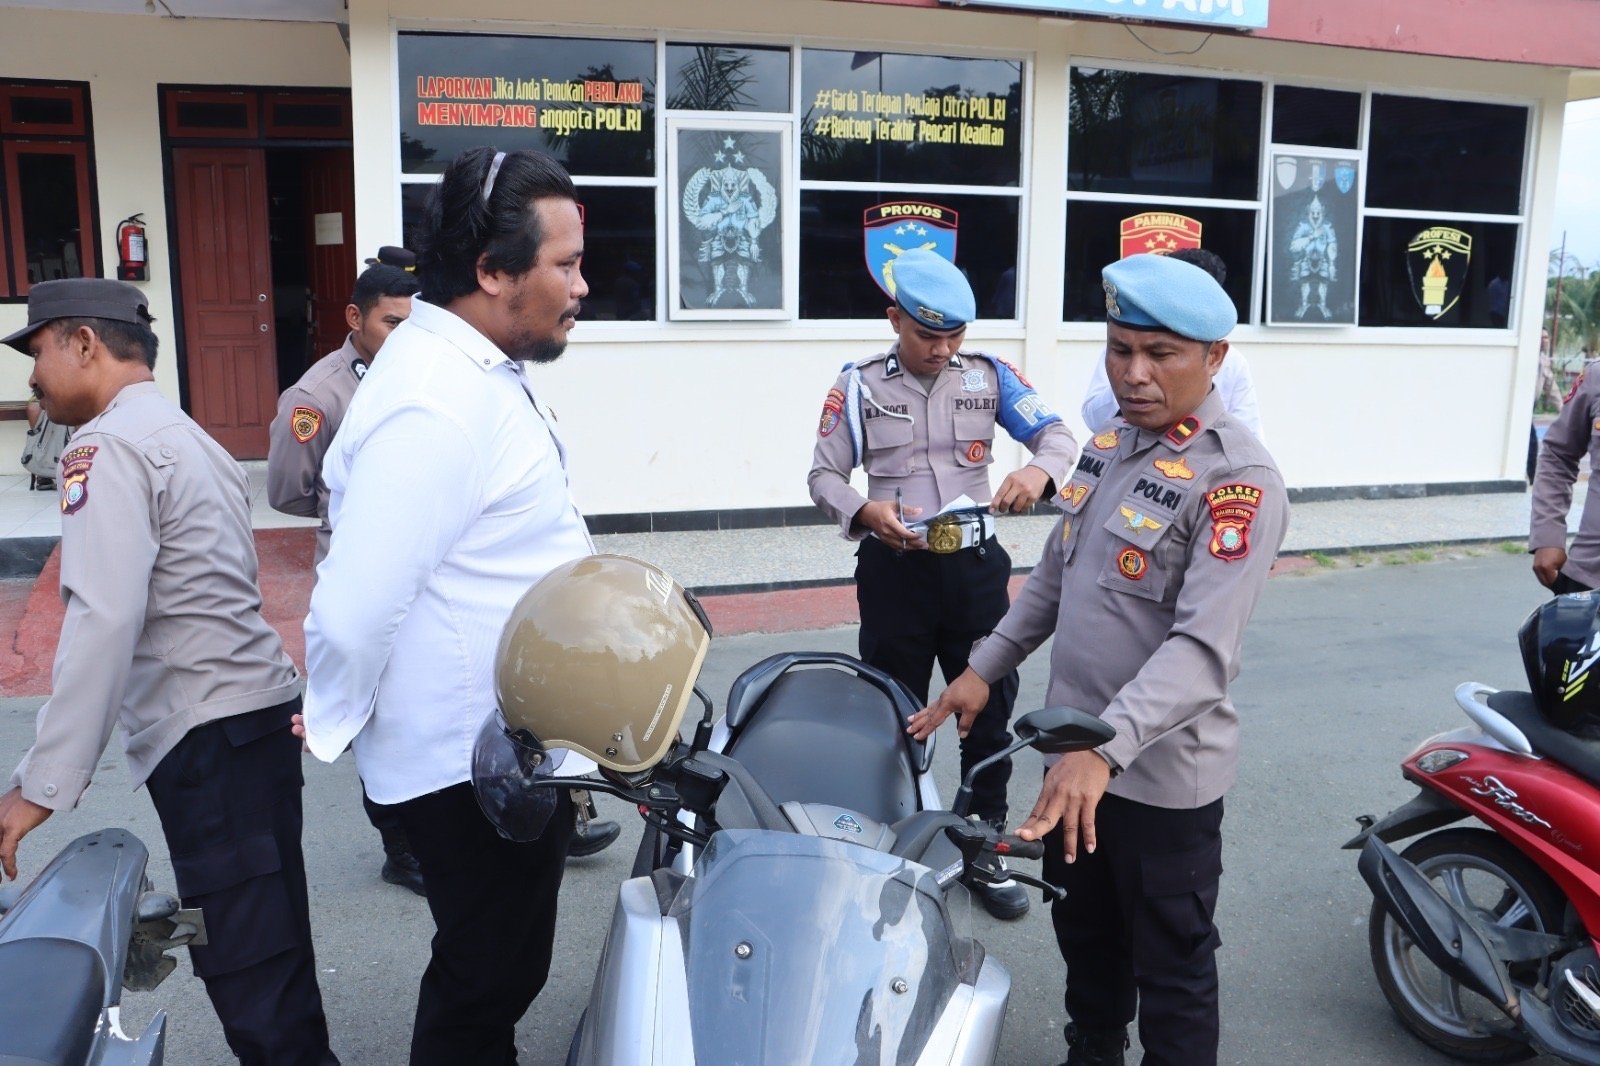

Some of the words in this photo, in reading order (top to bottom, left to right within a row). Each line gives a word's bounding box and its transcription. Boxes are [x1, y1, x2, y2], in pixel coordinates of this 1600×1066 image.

[417, 76, 493, 99] LAPORKAN
[493, 77, 514, 100] Jika
[515, 78, 540, 100] Anda
[541, 79, 584, 102] Temukan
[584, 80, 643, 104] PERILAKU
[418, 102, 537, 128] MENYIMPANG
[540, 107, 592, 136] anggota
[595, 107, 642, 131] POLRI
[814, 89, 858, 111] #Garda
[861, 91, 902, 118] Terdepan
[943, 95, 967, 118] Citra
[969, 97, 1006, 121] POLRI
[814, 116, 872, 144] #Benteng
[874, 118, 917, 141] Terakhir
[918, 120, 957, 144] Pencari
[960, 122, 1004, 146] Keadilan
[880, 204, 942, 219] PROVOS
[1134, 215, 1189, 230] PAMINAL
[954, 398, 996, 411] POLRI
[1133, 477, 1182, 511] POLRI
[1209, 485, 1260, 501] POLRES
